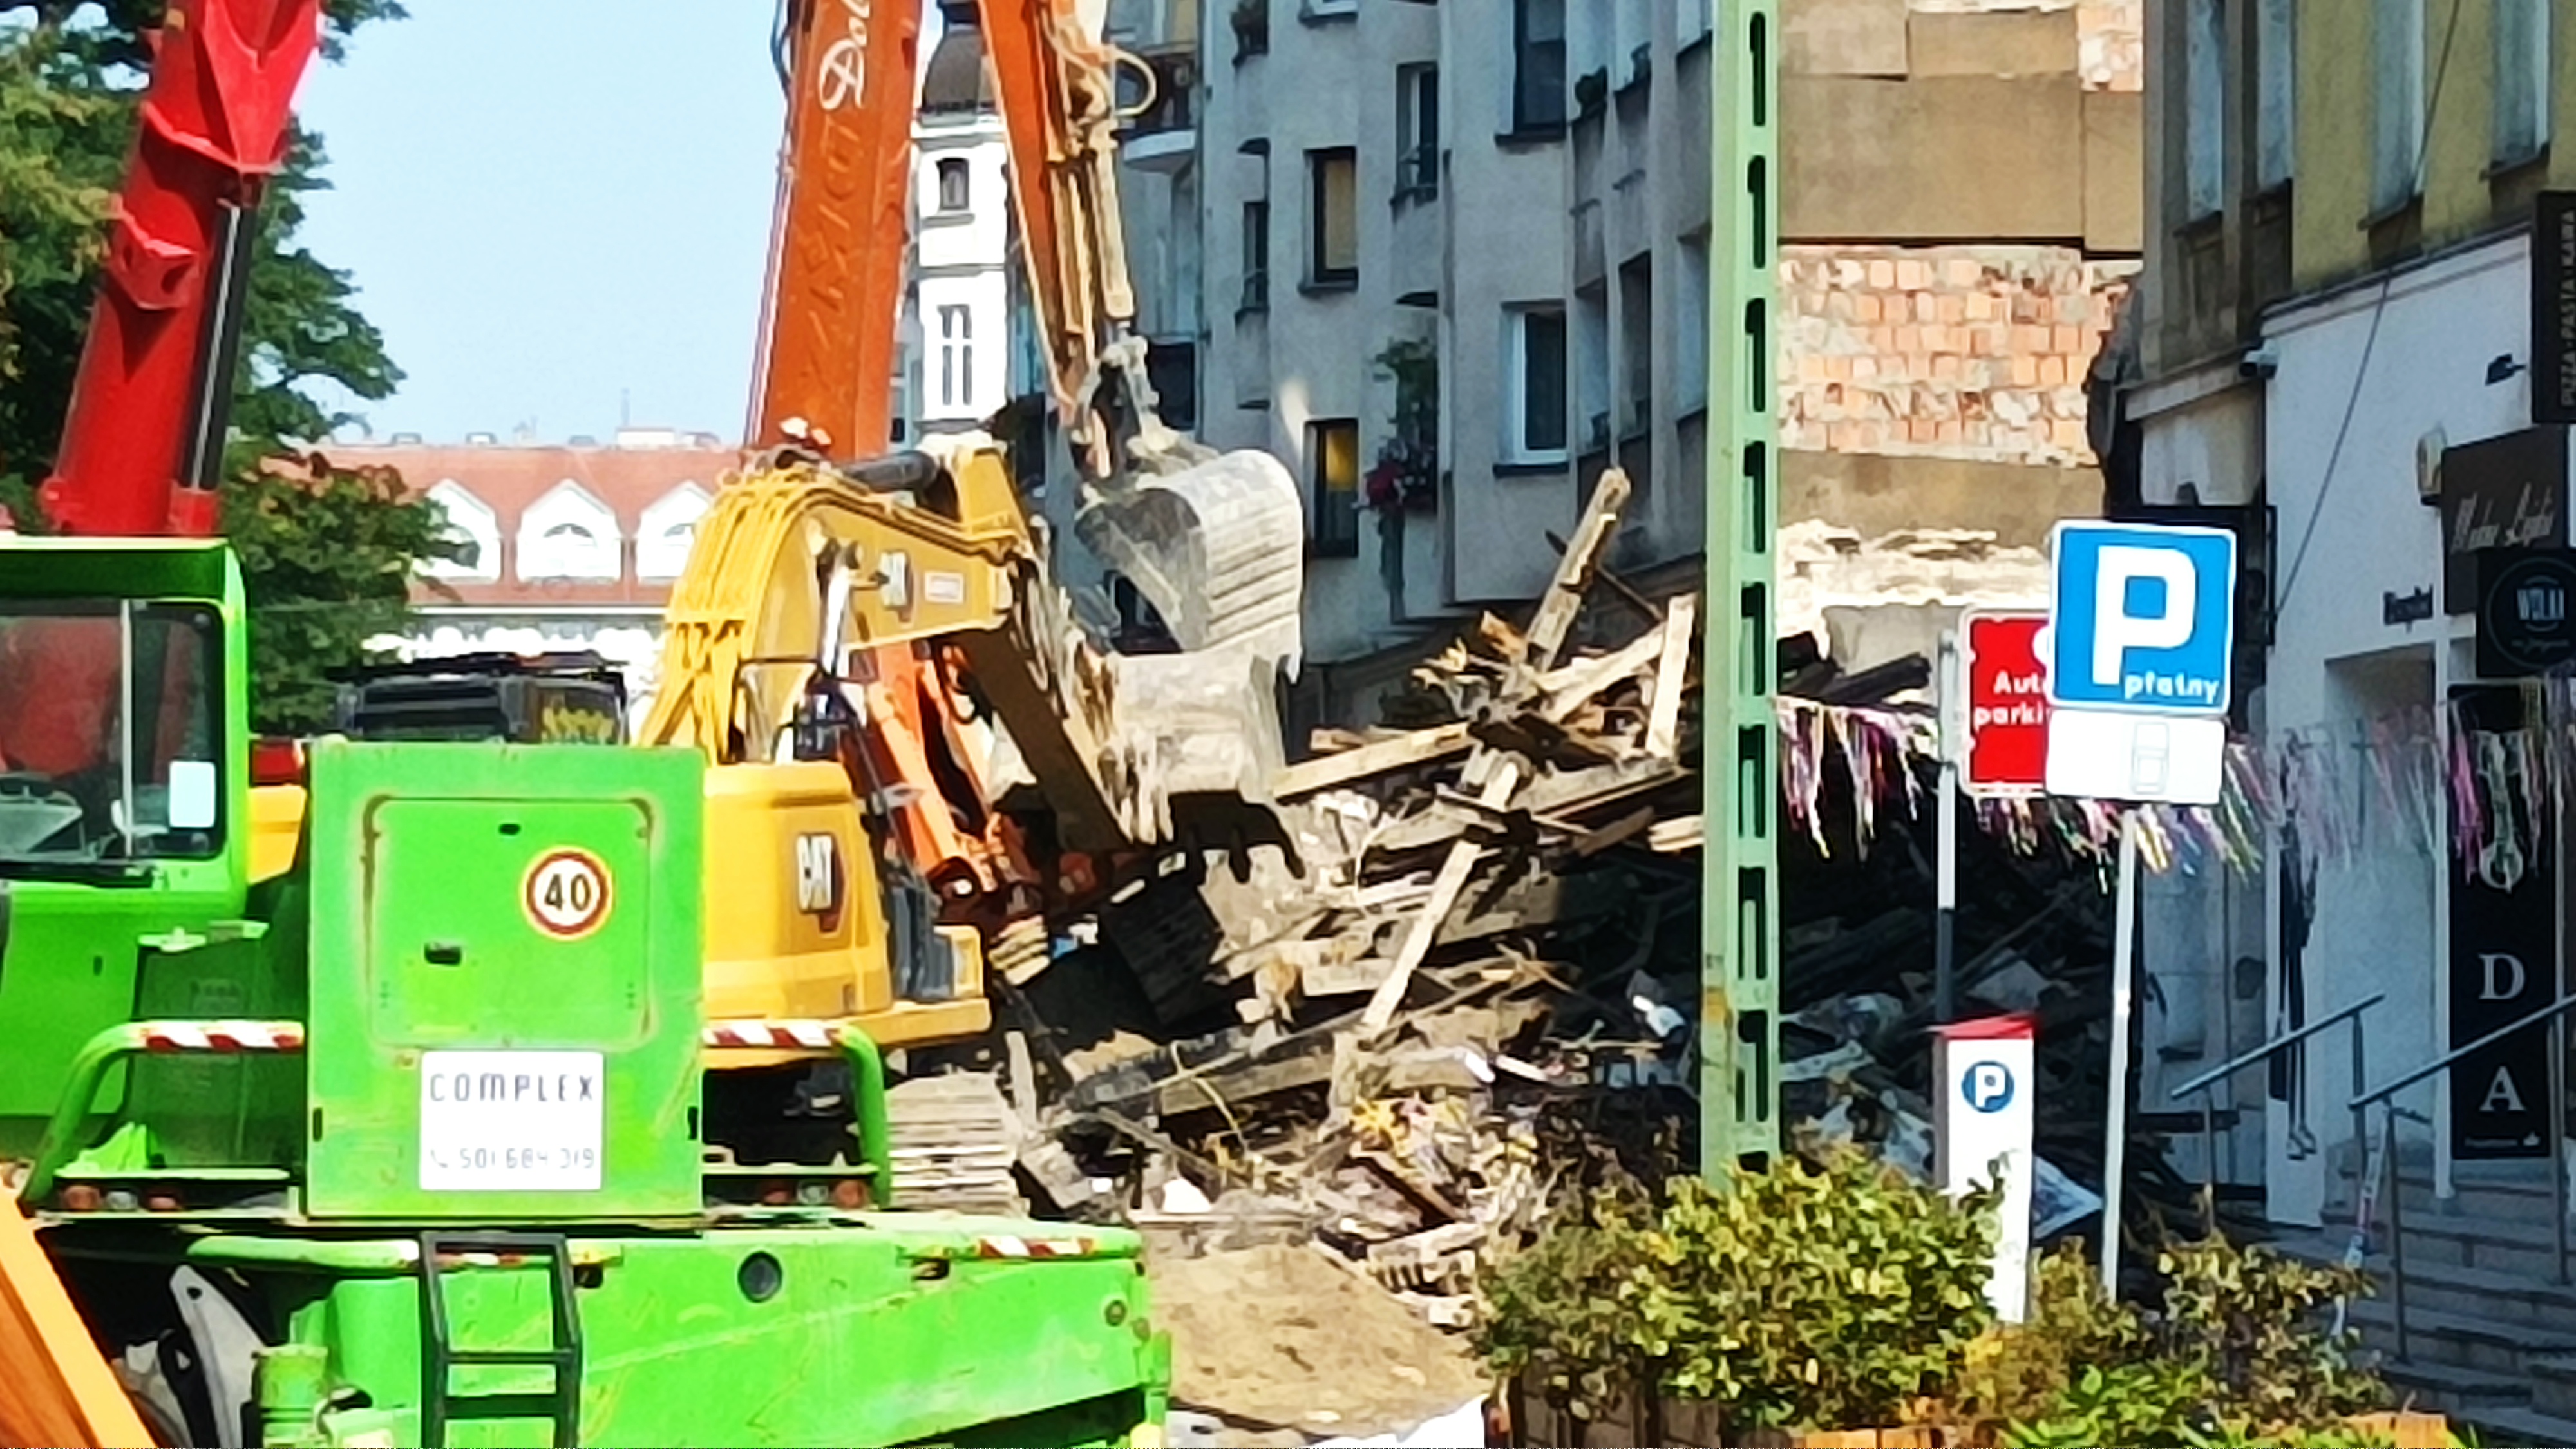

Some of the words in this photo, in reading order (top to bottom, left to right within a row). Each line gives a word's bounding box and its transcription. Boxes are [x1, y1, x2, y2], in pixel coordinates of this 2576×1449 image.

[2093, 545, 2197, 685] P
[1973, 701, 2050, 733] parki
[542, 873, 592, 912] 40
[430, 1072, 594, 1103] COMPLEX
[1974, 1065, 2007, 1108] P
